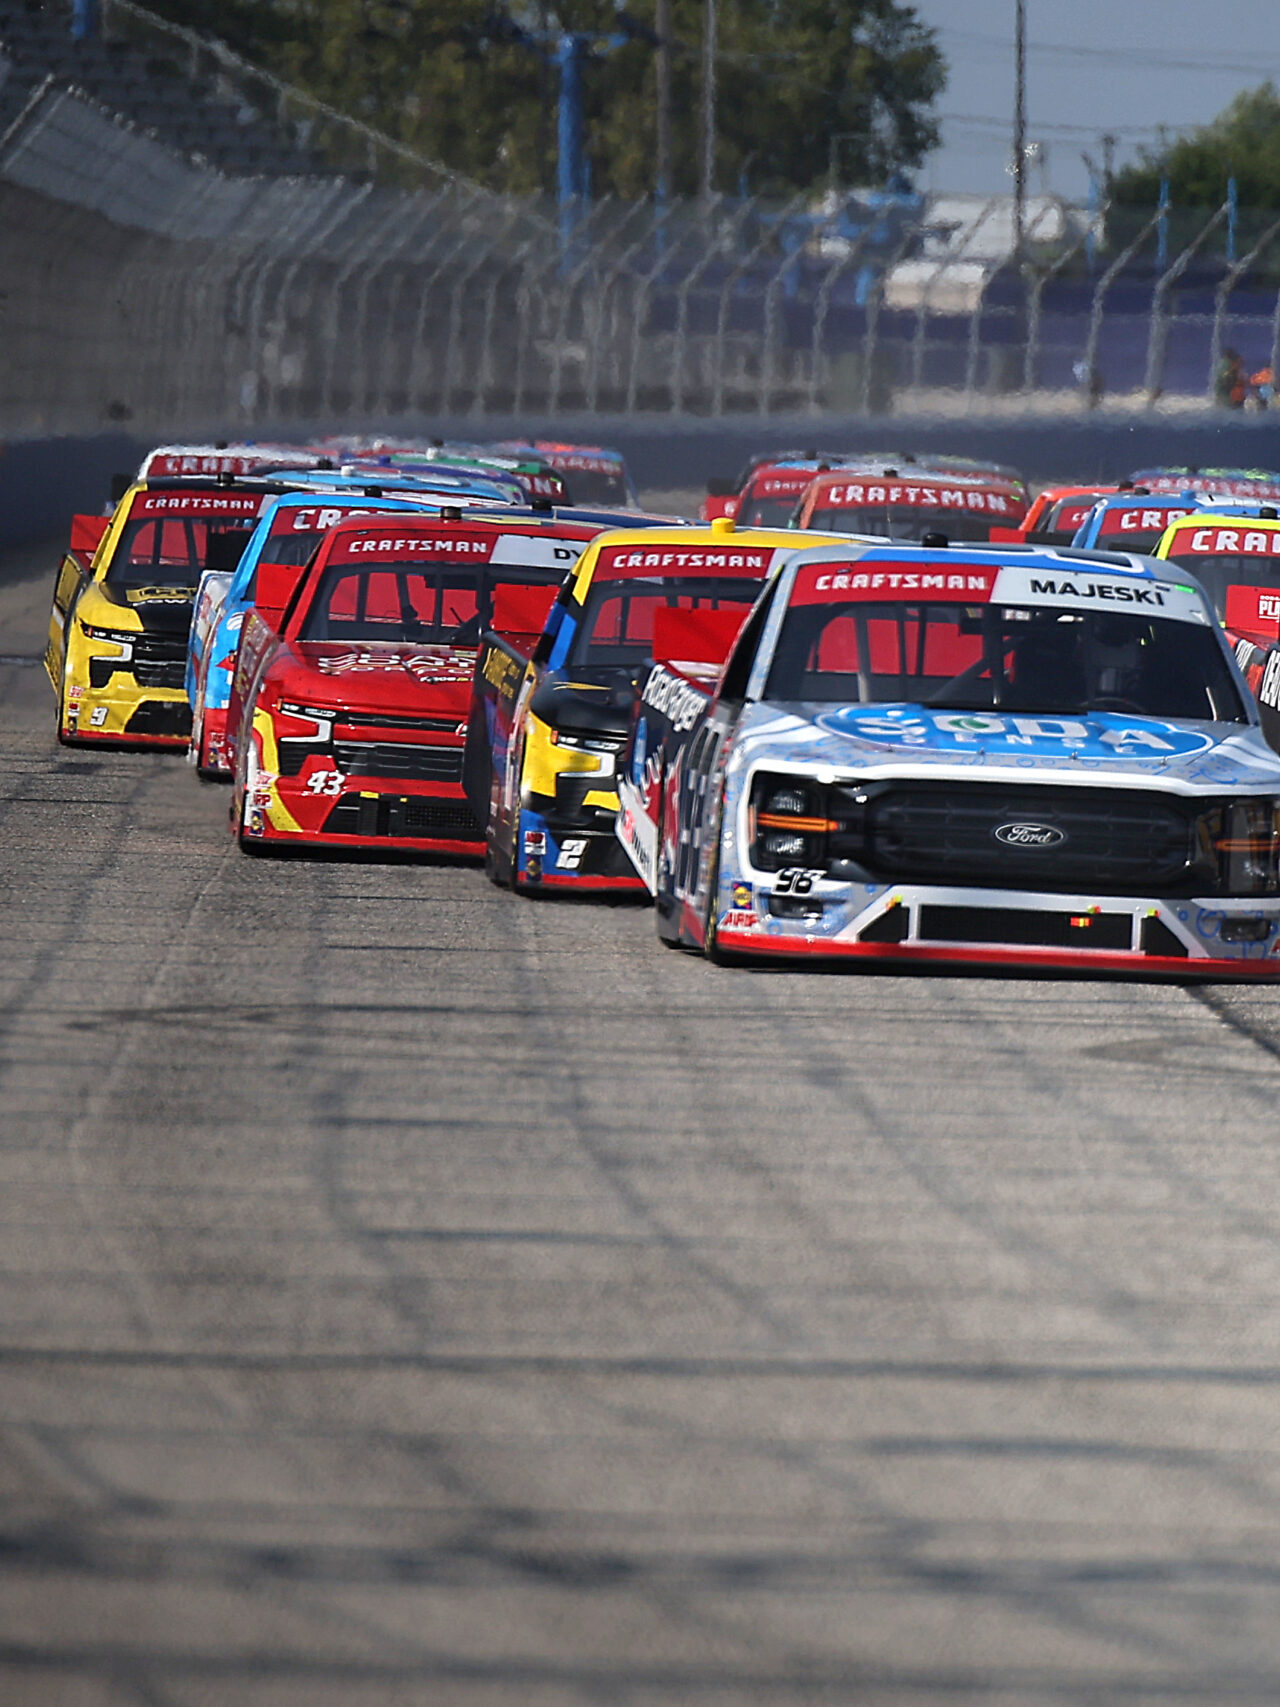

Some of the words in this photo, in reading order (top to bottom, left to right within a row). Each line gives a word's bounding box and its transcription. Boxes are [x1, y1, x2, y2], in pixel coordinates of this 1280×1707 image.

[145, 497, 255, 509] CRAFTSMAN
[829, 486, 1007, 512] CRAFTSMAN
[348, 539, 487, 554] CRAFTSMAN
[612, 552, 762, 569] CRAFTSMAN
[815, 572, 987, 592] CRAFTSMAN
[1031, 579, 1164, 606] MAJESKI
[307, 770, 346, 796] 43
[1005, 825, 1051, 846] Ford
[556, 839, 588, 869] 2
